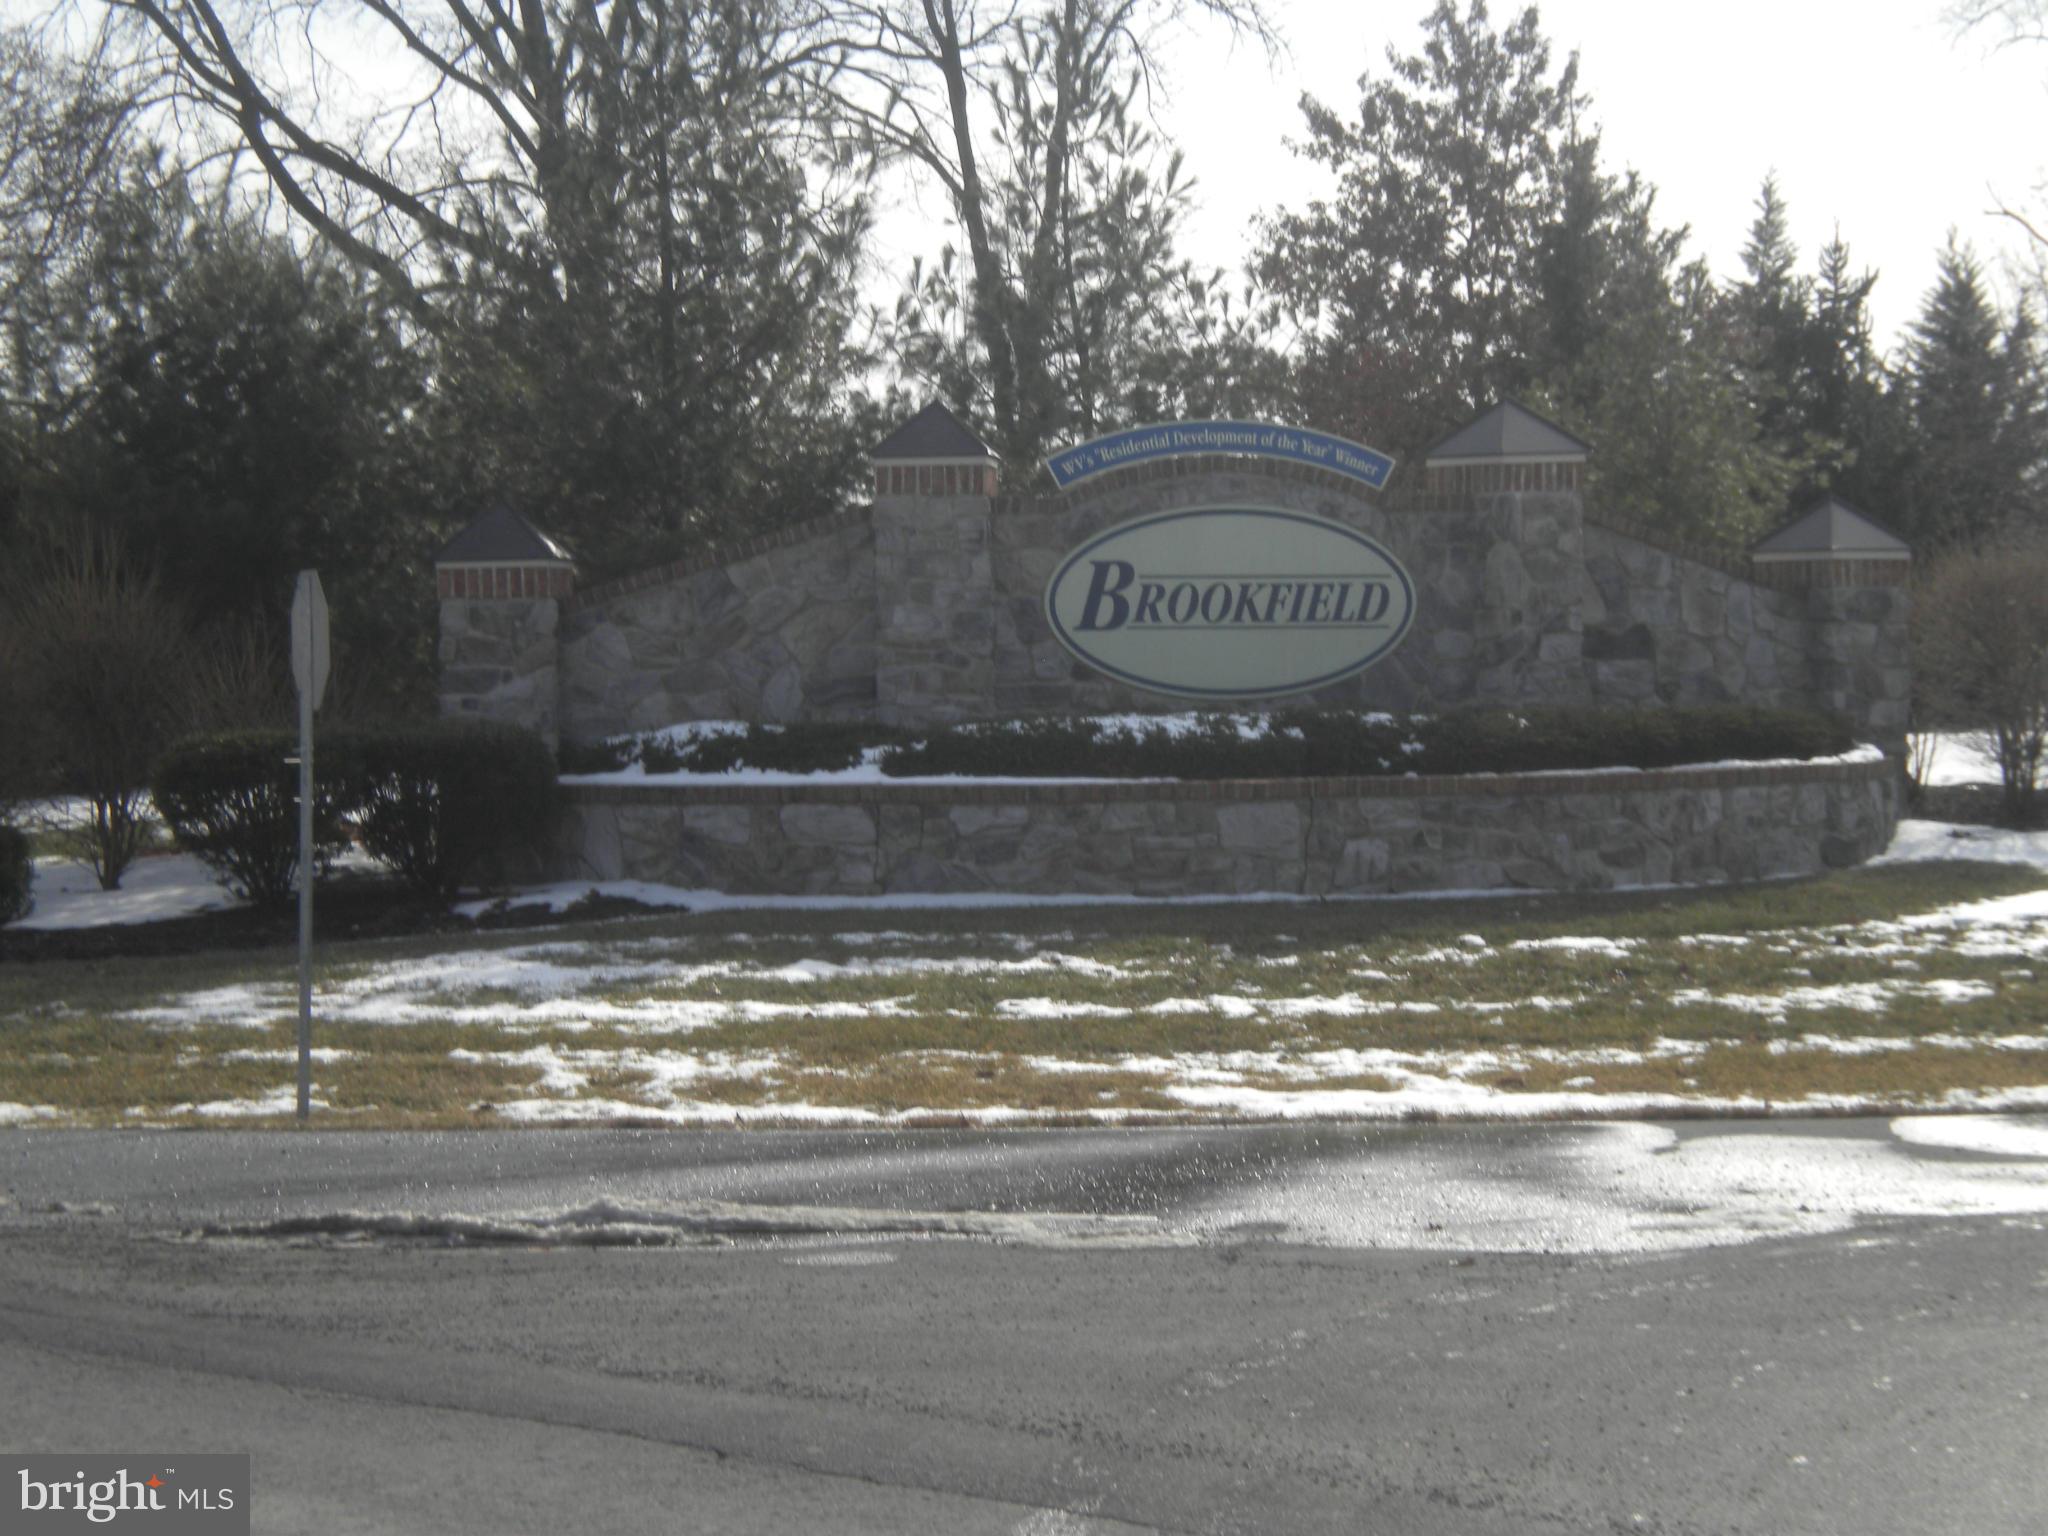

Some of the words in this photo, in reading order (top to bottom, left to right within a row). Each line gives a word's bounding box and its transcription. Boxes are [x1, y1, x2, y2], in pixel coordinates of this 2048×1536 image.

[1062, 454, 1094, 475] WV's
[1173, 428, 1257, 449] Development
[1261, 431, 1275, 447] of
[1277, 433, 1298, 450] the
[1335, 447, 1379, 476] Winner
[1073, 560, 1391, 632] BROOKFIELD
